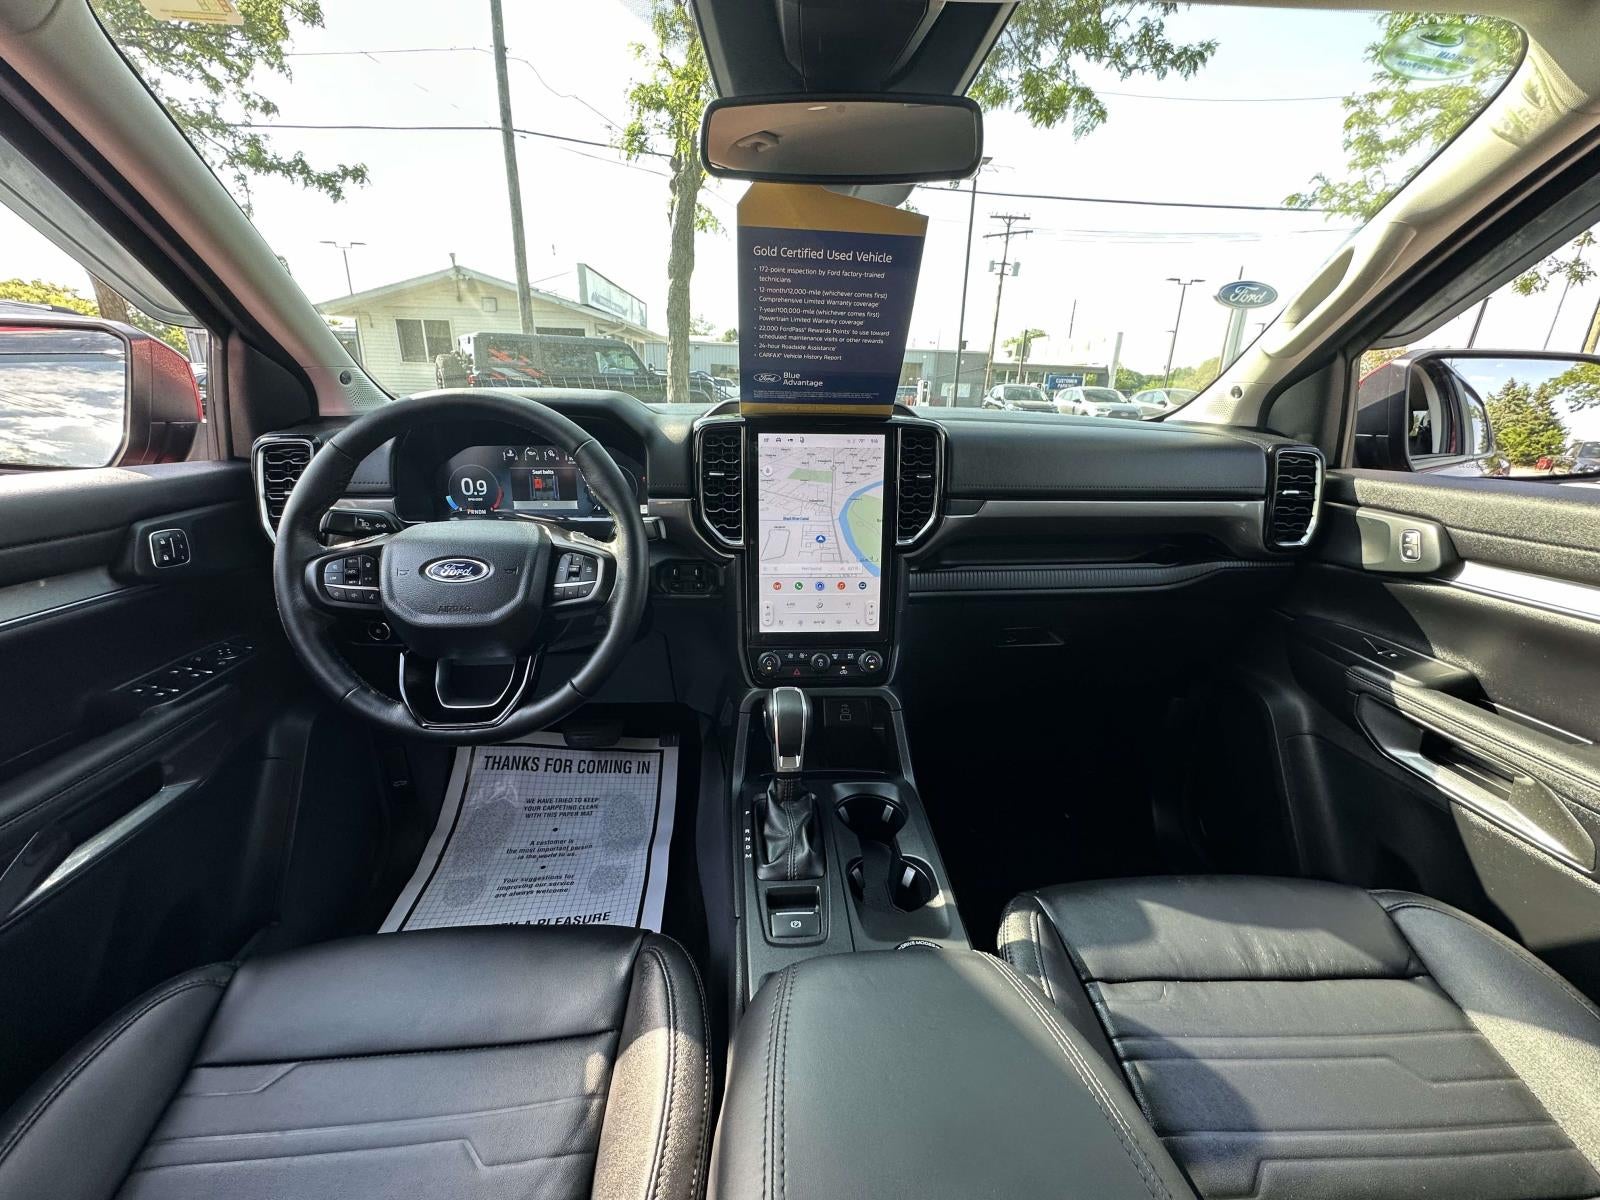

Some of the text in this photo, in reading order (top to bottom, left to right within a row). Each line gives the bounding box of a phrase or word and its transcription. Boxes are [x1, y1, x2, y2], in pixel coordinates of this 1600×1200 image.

[753, 245, 893, 264] Gold Certified Used Vehicle
[759, 266, 786, 275] 172-point
[786, 267, 816, 276] inspection
[818, 268, 826, 277] by
[842, 270, 885, 280] factory-trained
[759, 275, 792, 284] technicians
[822, 290, 853, 298] (whichever
[854, 291, 873, 299] comes
[874, 292, 888, 300] first)
[1229, 285, 1268, 303] Ford
[758, 295, 802, 304] Comprehensive
[804, 297, 825, 305] Limited
[826, 298, 852, 307] Warranty
[816, 308, 846, 317] (whichever
[866, 311, 880, 319] first)
[812, 317, 838, 325] Warranty
[870, 329, 890, 337] toward
[846, 336, 861, 344] other
[758, 342, 780, 350] 24-hour
[783, 352, 802, 360] Vehicle
[804, 353, 823, 361] History
[824, 354, 842, 362] Report
[757, 373, 777, 382] Ford
[783, 372, 801, 380] Blue
[782, 379, 824, 388] Advantage
[460, 477, 488, 496] 0.9
[440, 562, 473, 577] Ford
[484, 754, 651, 774] THANKS FOR COMING IN
[570, 844, 593, 852] person
[520, 874, 562, 883] suggestions
[536, 911, 612, 925] PLEASURE
